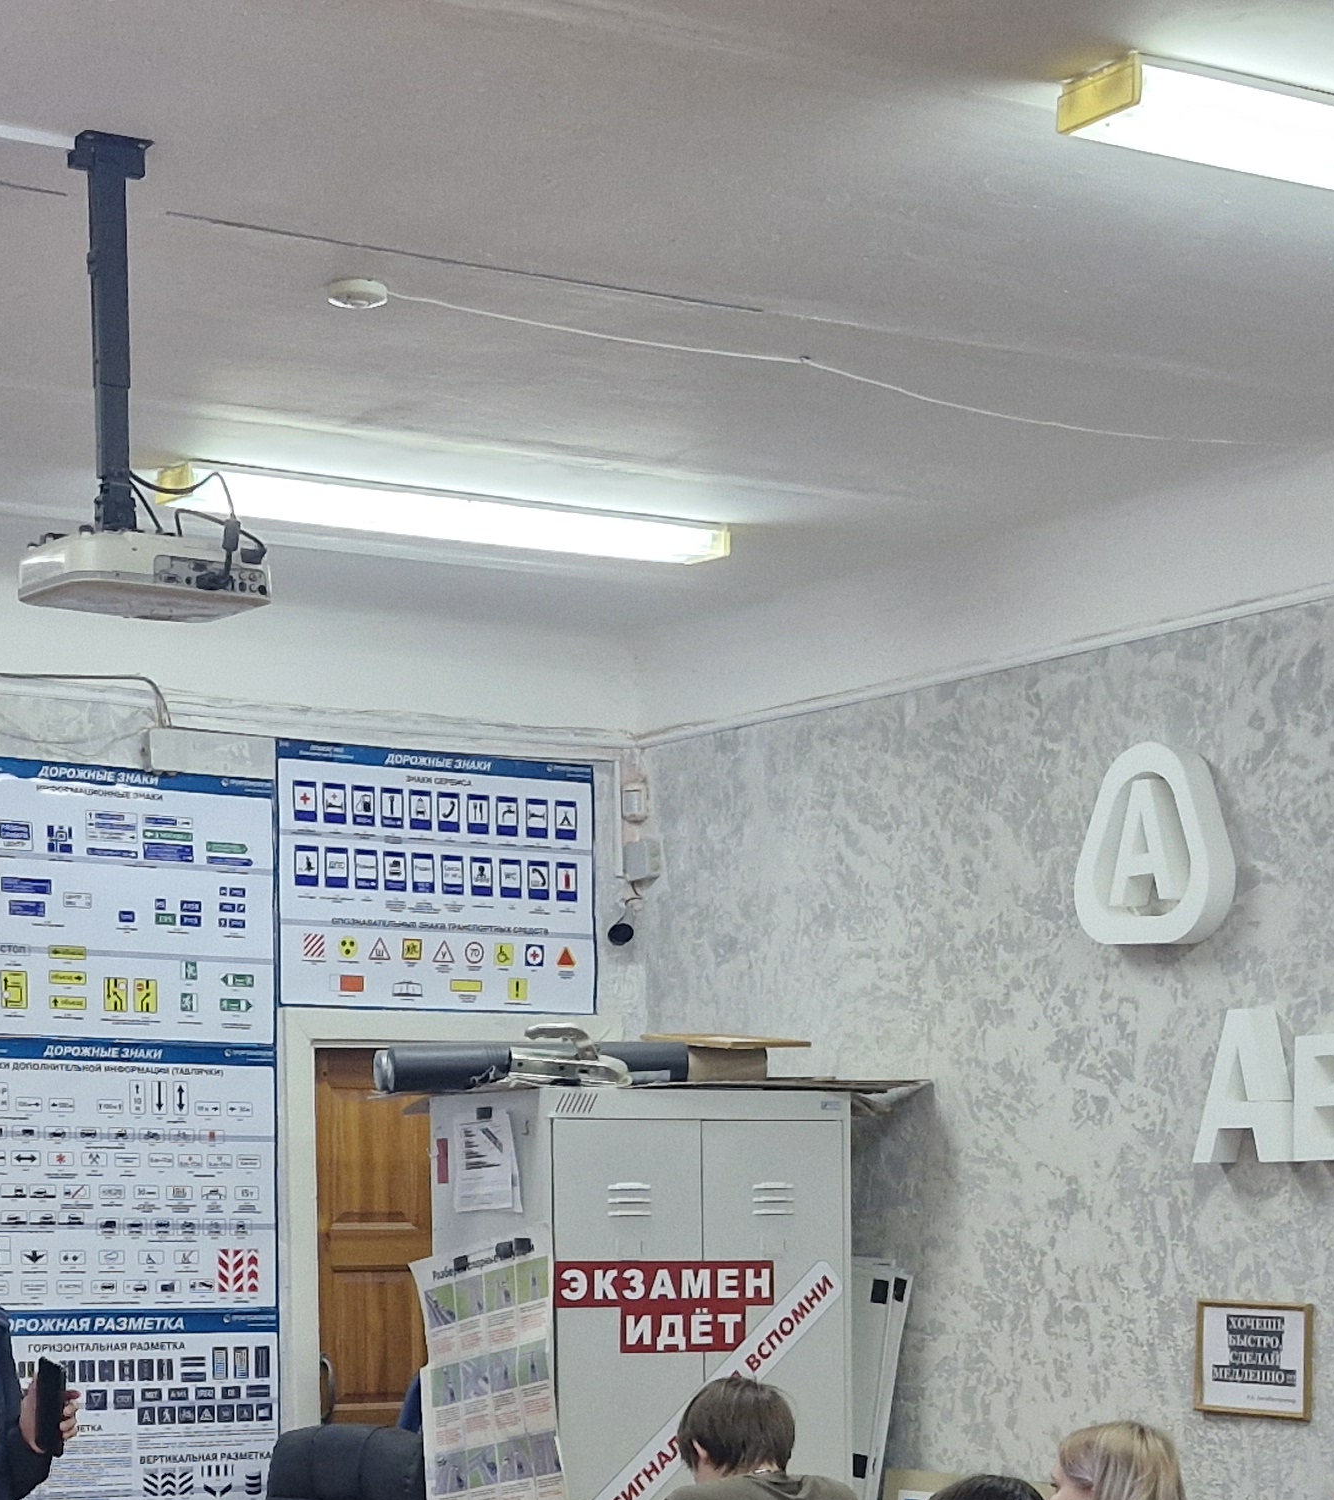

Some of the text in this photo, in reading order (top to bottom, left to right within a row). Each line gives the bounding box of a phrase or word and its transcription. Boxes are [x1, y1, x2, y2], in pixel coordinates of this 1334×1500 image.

[384, 753, 492, 772] ДОРОЖНЫЕ ЗНАКИ
[37, 765, 160, 786] ДОРОЖНЫЕ ЗНАКИ
[43, 1044, 163, 1060] ДОРОЖНЫЕ ЗНАКИ
[11, 1061, 102, 1075] ДОПОЛНИТЕЛЬНОЙ
[560, 1267, 772, 1301] ЭКЗАМЕН
[94, 1316, 186, 1332] РАЗМЕТКА
[625, 1308, 742, 1351] ИДЁТ
[744, 1274, 835, 1374] ВСПОМНИ
[28, 1340, 186, 1353] ГОРИЗОНТАЛЬНАЯ РАЗМЕТКА
[1230, 1351, 1280, 1366] СДЕЛАЙ
[1212, 1367, 1285, 1384] МЕДЛЕННО
[140, 1452, 272, 1465] ВЕРТИКАЛЬНАЯ РАЗМЕТКА
